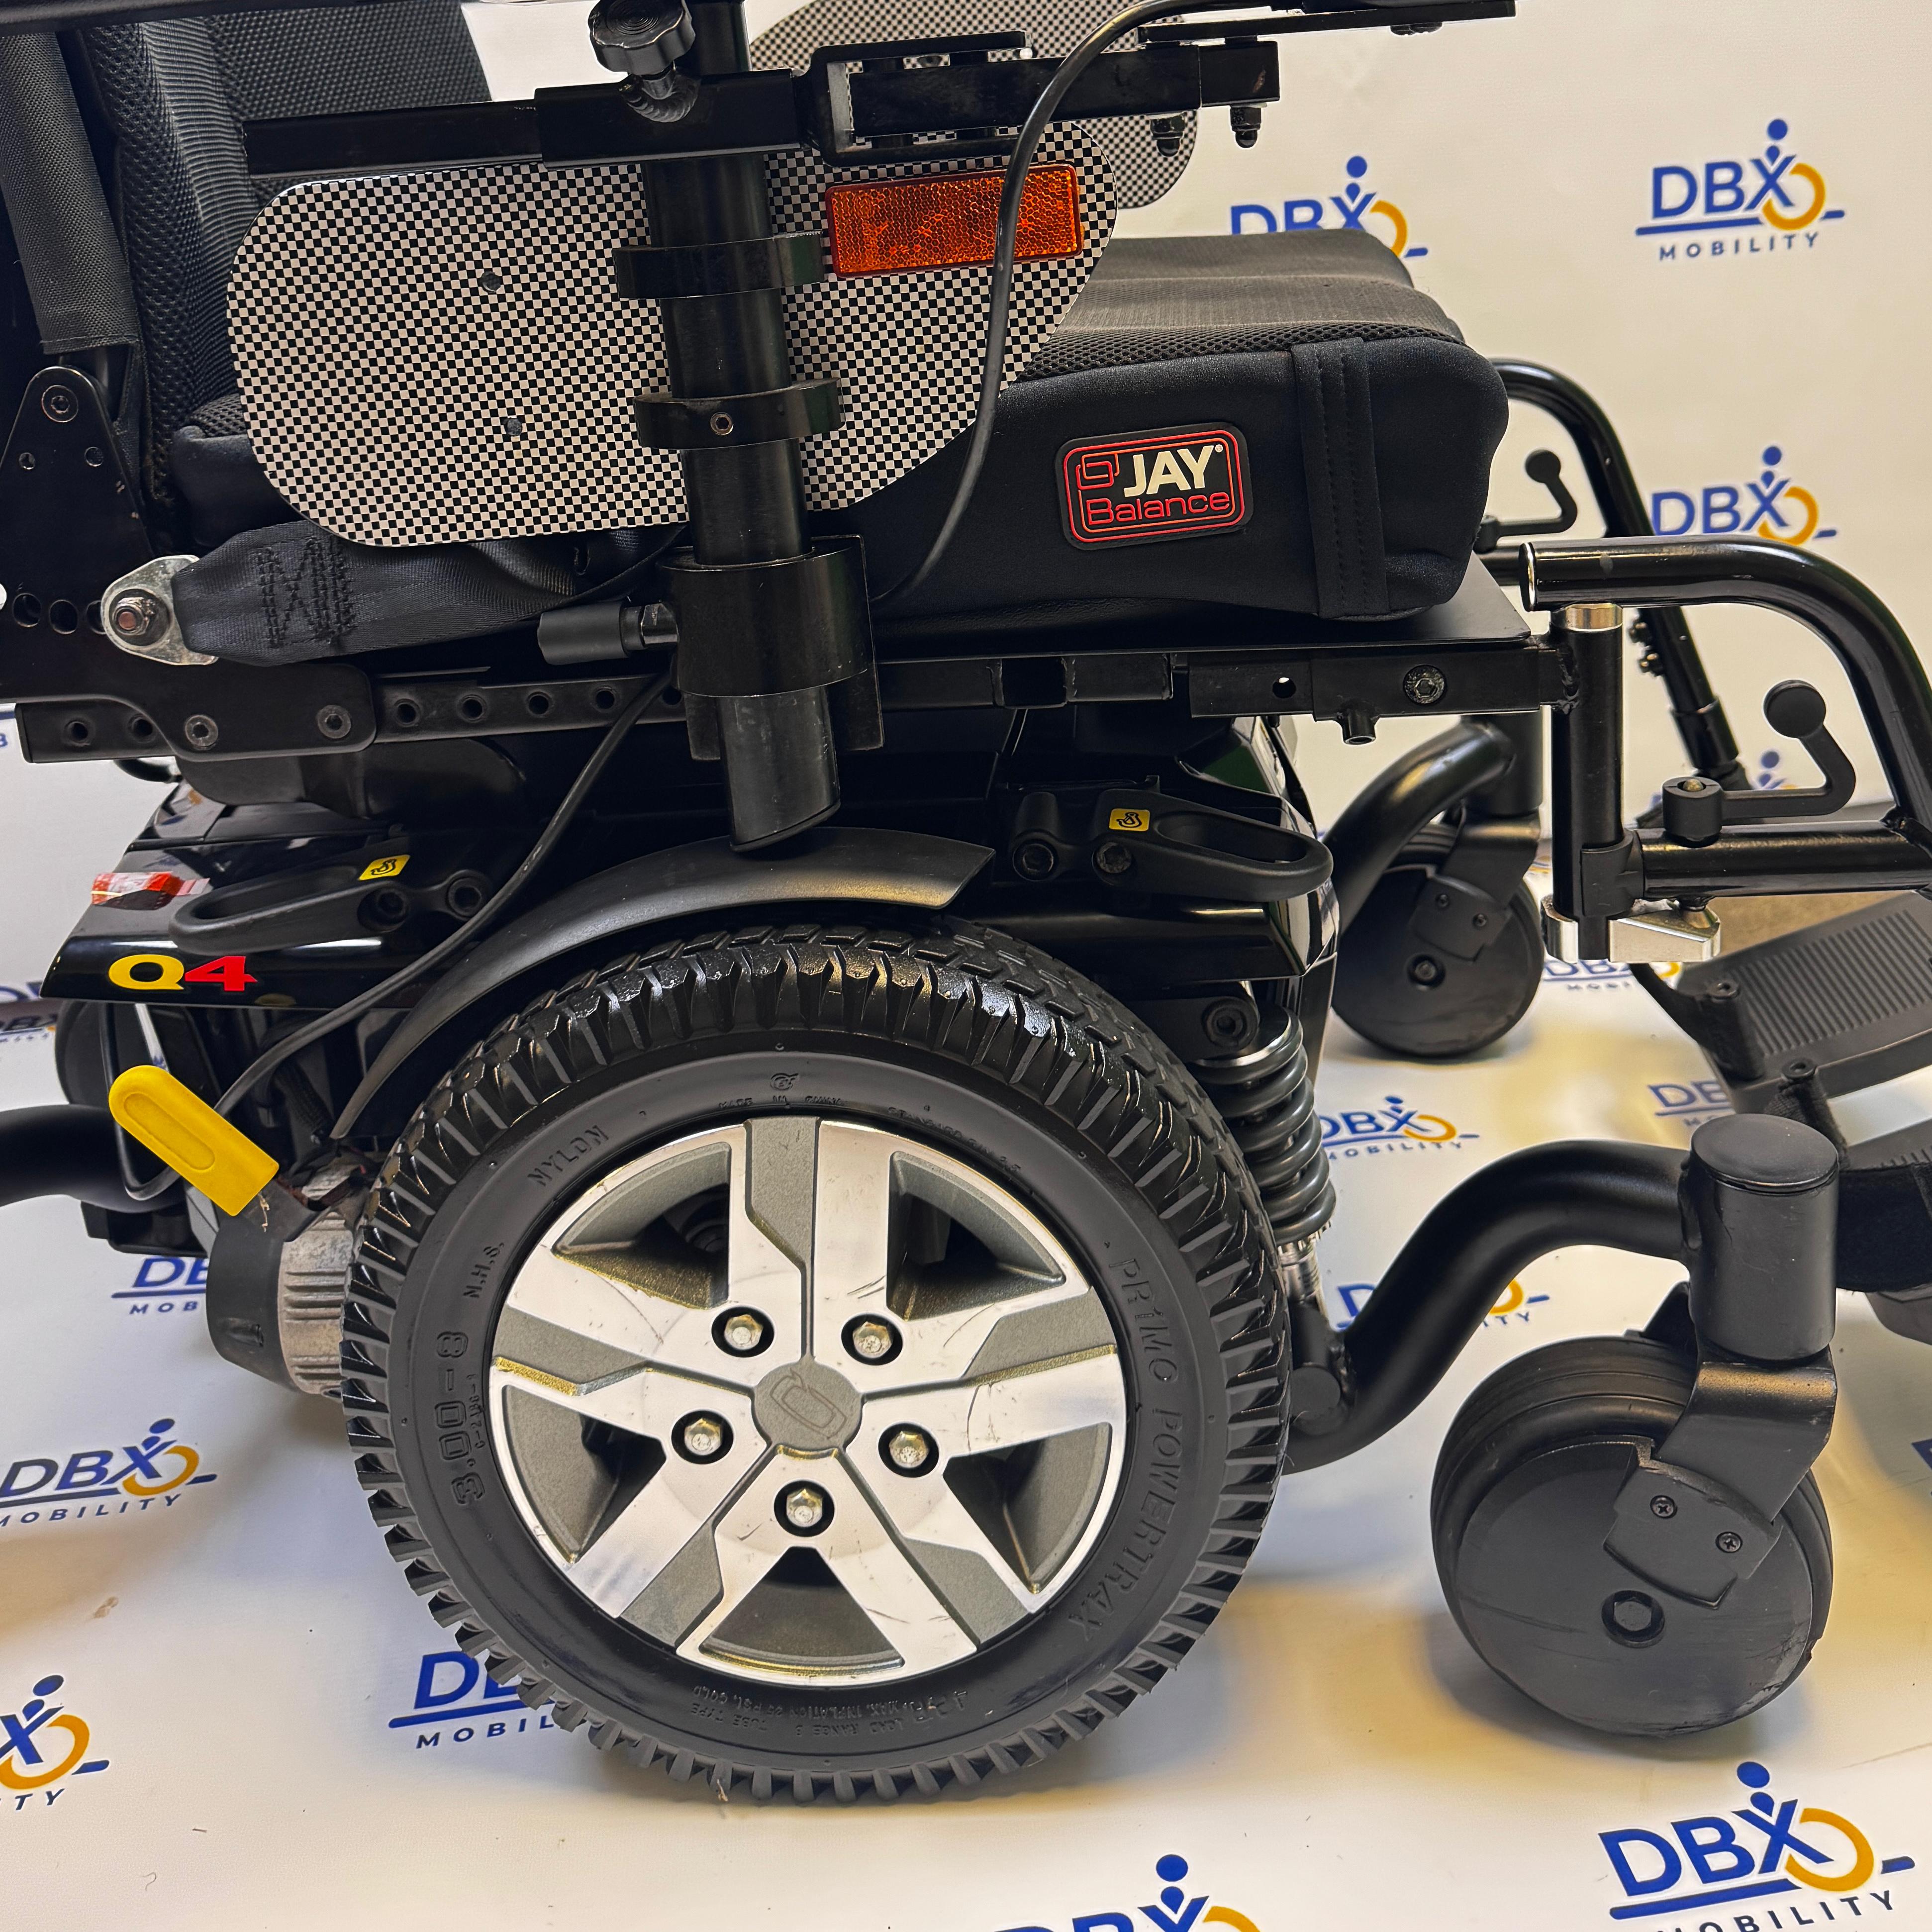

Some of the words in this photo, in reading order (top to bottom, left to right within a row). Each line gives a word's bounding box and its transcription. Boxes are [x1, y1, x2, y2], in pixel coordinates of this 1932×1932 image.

[1652, 154, 1797, 219] DBX
[1659, 231, 1819, 261] MOBILITY
[1086, 491, 1230, 525] Balance
[1651, 478, 1791, 536] DBX
[107, 954, 258, 991] Q4
[527, 1124, 609, 1187] NYLON
[1108, 1257, 1178, 1383] PRIMO
[434, 1330, 486, 1506] 3.00-8
[415, 1715, 554, 1749] MOBIL
[1597, 1799, 1835, 1897] DBX
